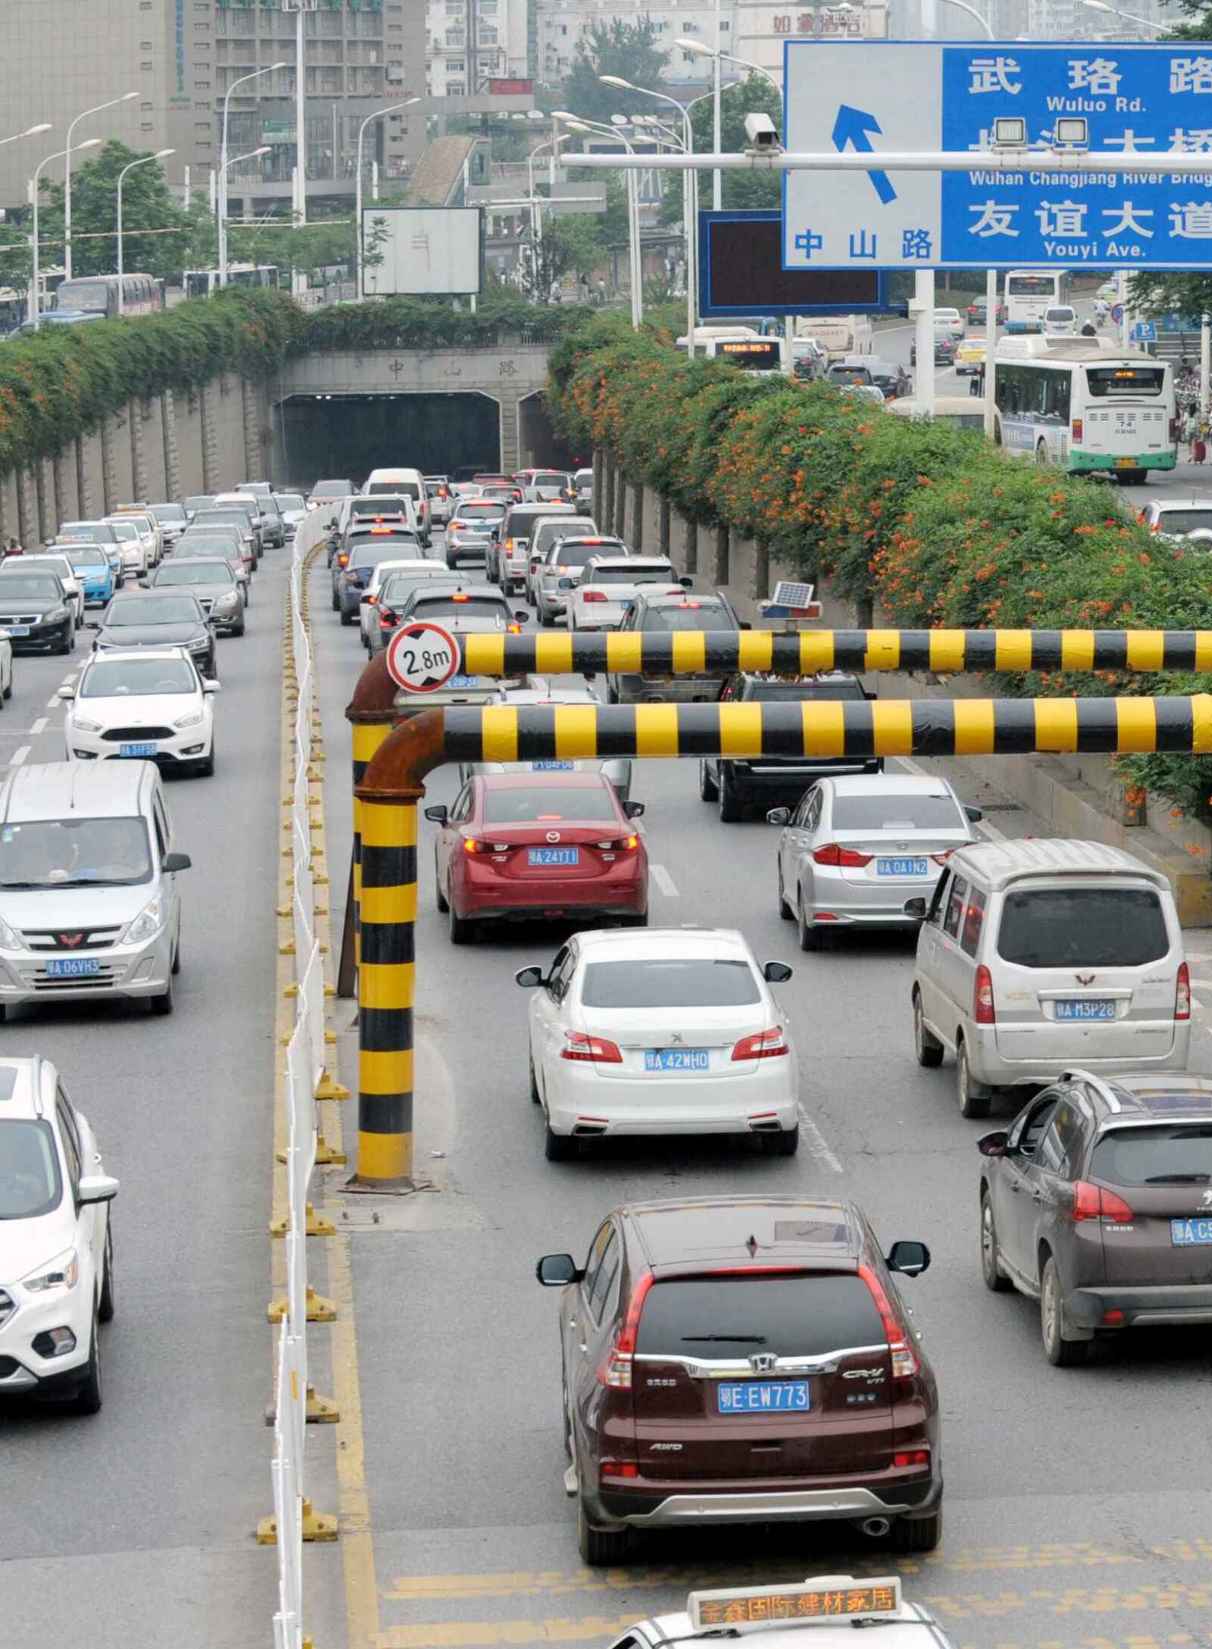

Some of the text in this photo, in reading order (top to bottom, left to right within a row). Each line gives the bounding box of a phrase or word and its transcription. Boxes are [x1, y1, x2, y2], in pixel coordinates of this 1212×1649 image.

[1047, 96, 1147, 112] Wuluo Rd.
[969, 171, 1024, 185] Wuhan
[1030, 171, 1117, 188] Changjiang
[1122, 173, 1165, 185] River
[794, 229, 934, 260] 中山路
[1044, 242, 1147, 259] Youyi Ave.
[402, 650, 450, 675] 2.8m
[650, 1442, 683, 1451] AWD
